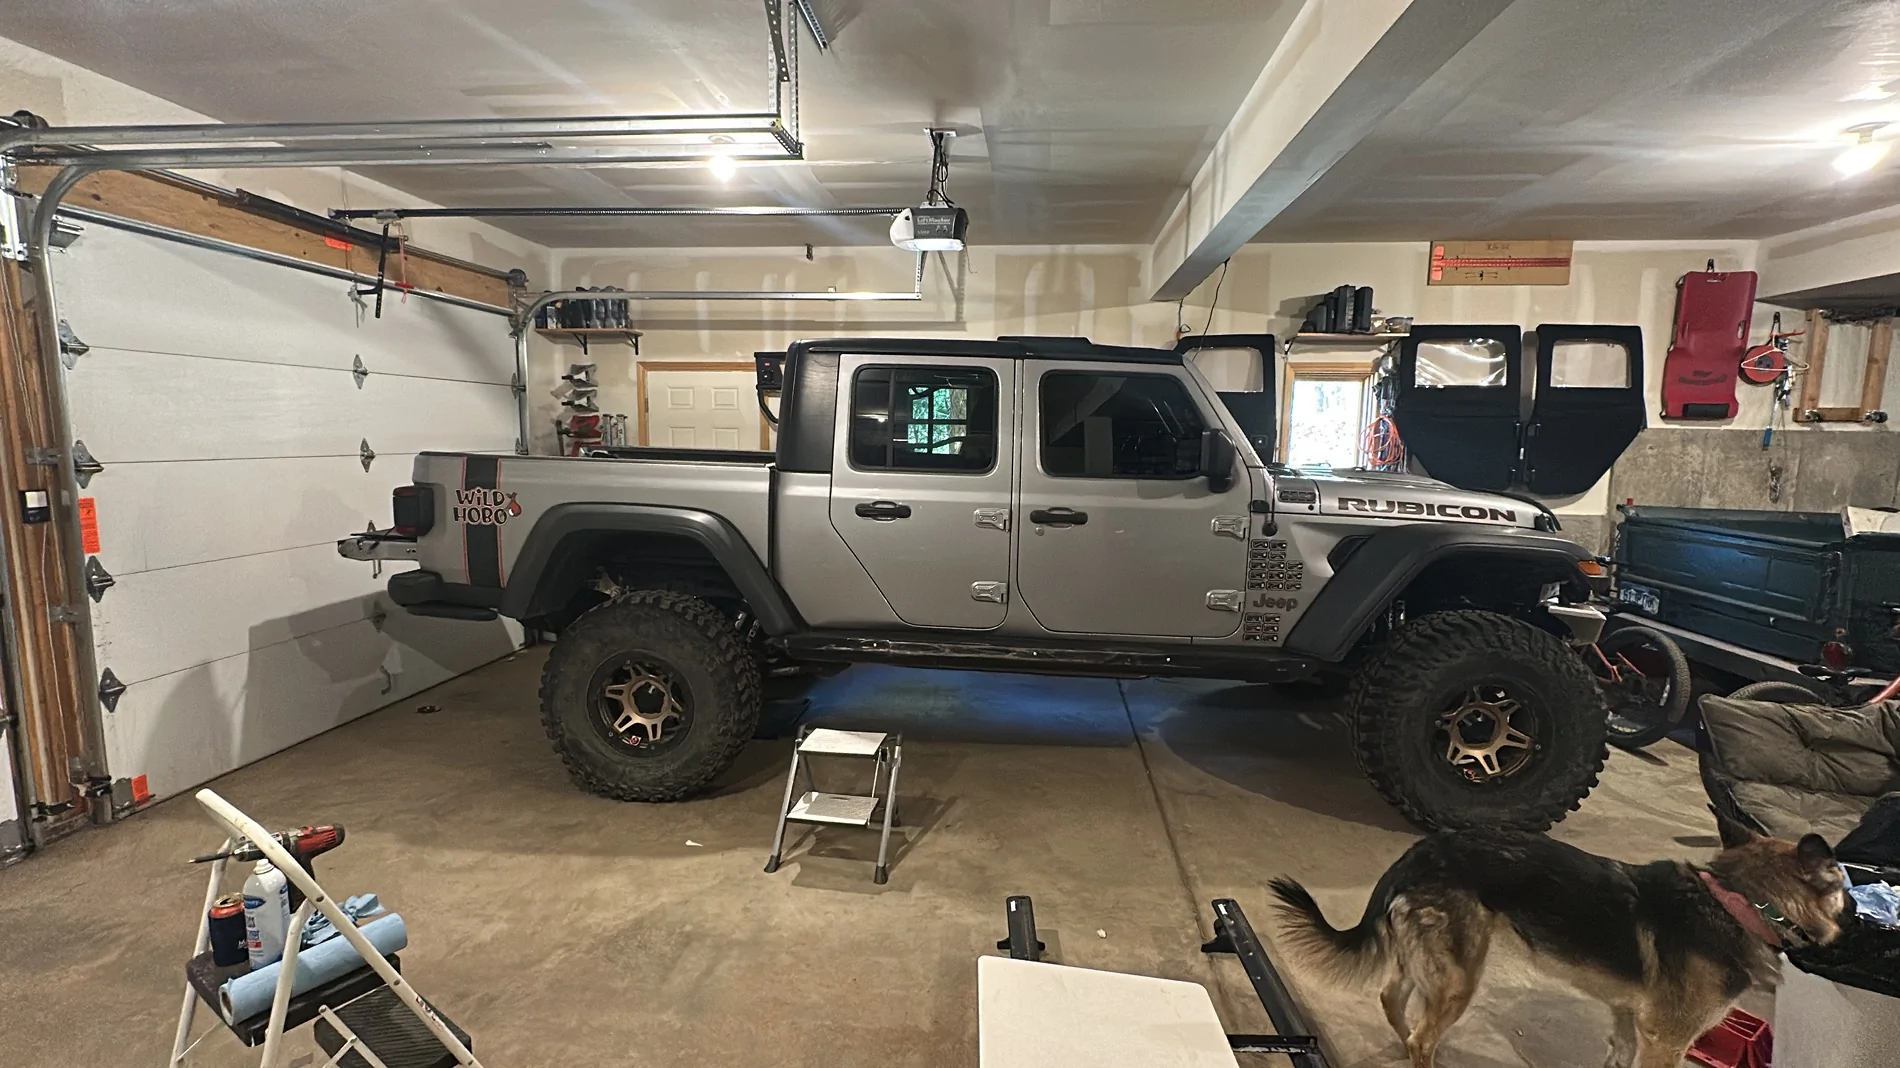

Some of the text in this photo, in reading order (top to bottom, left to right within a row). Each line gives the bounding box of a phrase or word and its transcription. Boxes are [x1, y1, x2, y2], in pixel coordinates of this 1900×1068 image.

[453, 507, 508, 524] HOBO
[1337, 497, 1517, 522] RUBICON
[1252, 593, 1299, 612] Jeep
